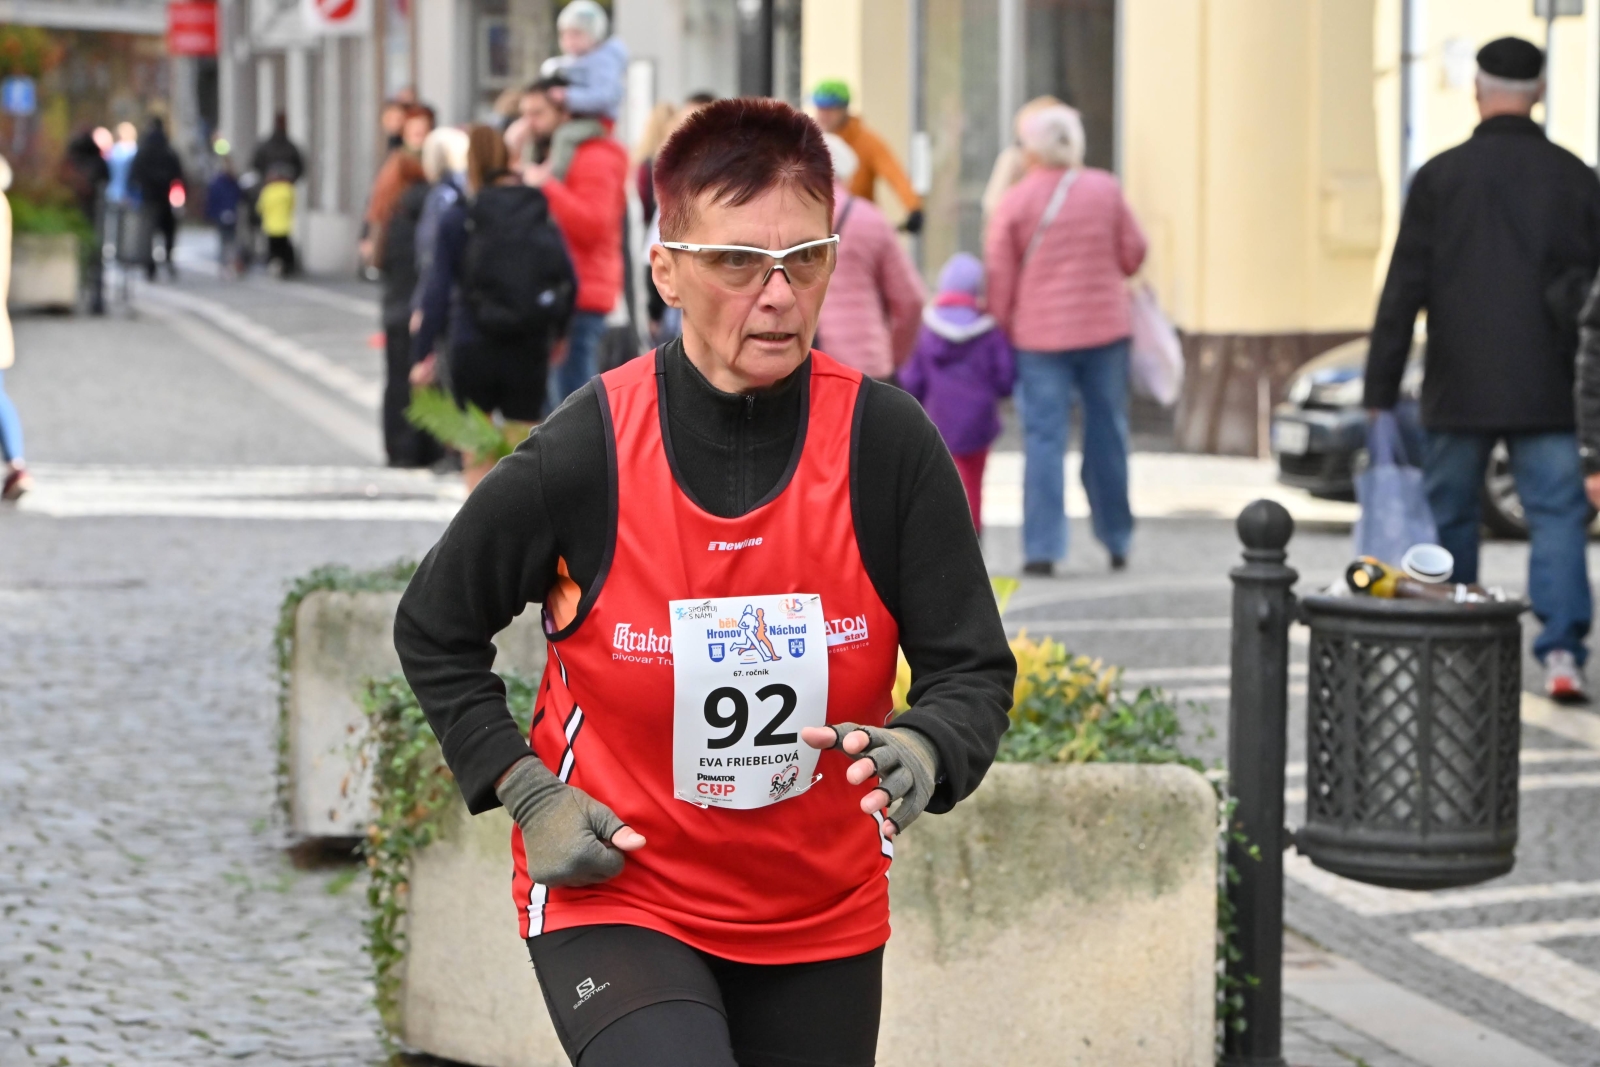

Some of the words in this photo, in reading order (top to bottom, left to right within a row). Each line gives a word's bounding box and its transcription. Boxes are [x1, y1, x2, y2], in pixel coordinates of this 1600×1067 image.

[718, 618, 738, 629] běh
[706, 628, 742, 639] Hronov
[769, 624, 807, 636] Náchod
[844, 632, 866, 642] stav
[612, 652, 653, 664] pivovar
[745, 668, 770, 676] ročník
[703, 683, 798, 750] 92
[700, 757, 723, 768] EVA
[726, 750, 800, 767] FRIEBELOVÁ
[696, 782, 736, 797] CUP
